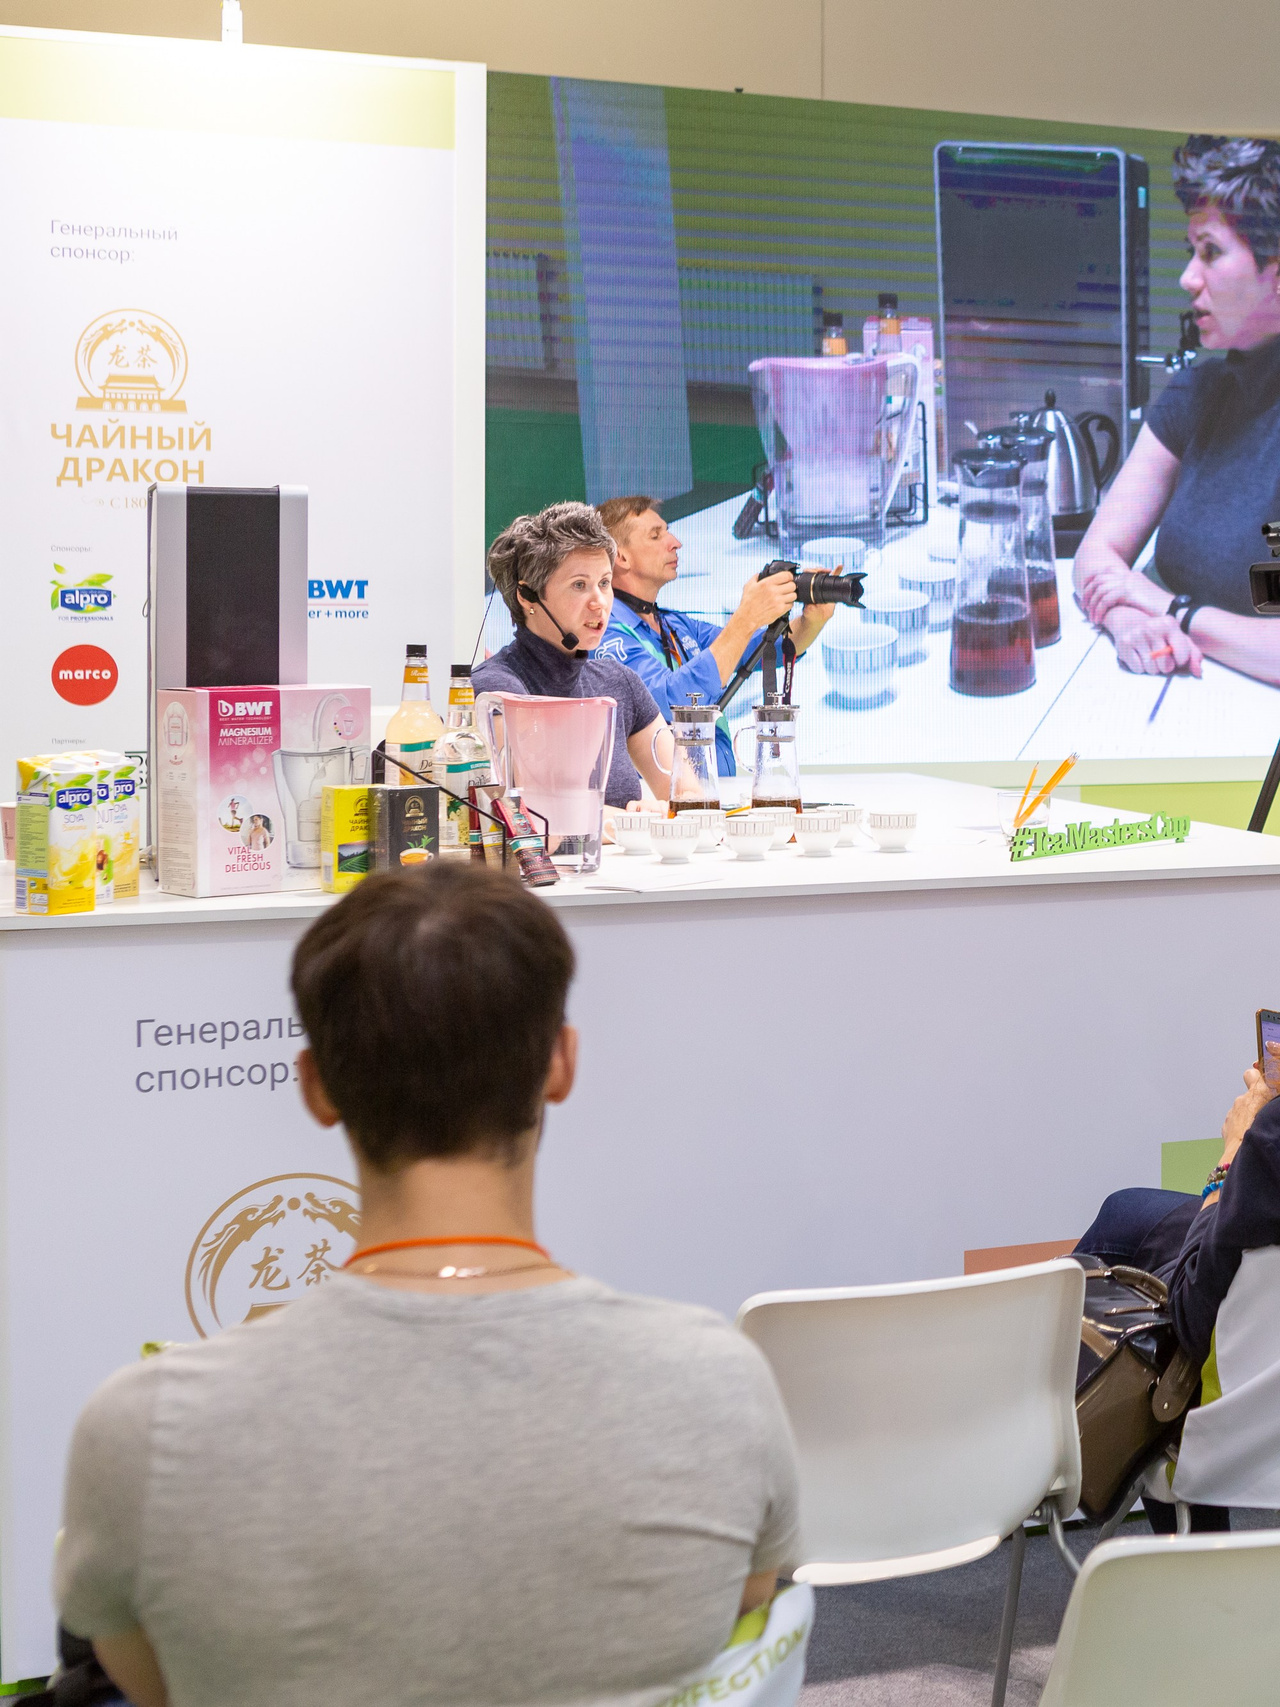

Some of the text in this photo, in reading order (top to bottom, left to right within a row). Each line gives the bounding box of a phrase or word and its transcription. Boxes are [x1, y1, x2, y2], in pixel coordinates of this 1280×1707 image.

[50, 219, 179, 242] Генеральный
[50, 243, 135, 264] спонсор:
[50, 418, 212, 452] ЧАЙНЫЙ
[56, 456, 205, 487] ДРАКОН
[124, 497, 148, 509] 180
[308, 579, 369, 599] BWT
[64, 590, 109, 608] alpro
[308, 610, 322, 619] er
[335, 610, 369, 619] more
[58, 668, 112, 681] marco
[784, 661, 792, 694] Canon
[235, 701, 273, 716] BWT
[220, 727, 272, 738] MAGNESIUM
[218, 736, 274, 747] MINERALIZER
[114, 783, 133, 795] pro
[58, 789, 91, 807] alpro
[64, 813, 85, 825] SOYA
[349, 817, 370, 825] ЧАЙН
[1010, 811, 1191, 862] #TeaMastersCup
[227, 846, 252, 855] VITAL
[236, 854, 264, 863] FRESH
[225, 861, 271, 873] DELICIOUS
[135, 1012, 306, 1049] Генераль
[135, 1057, 300, 1094] спонсор:
